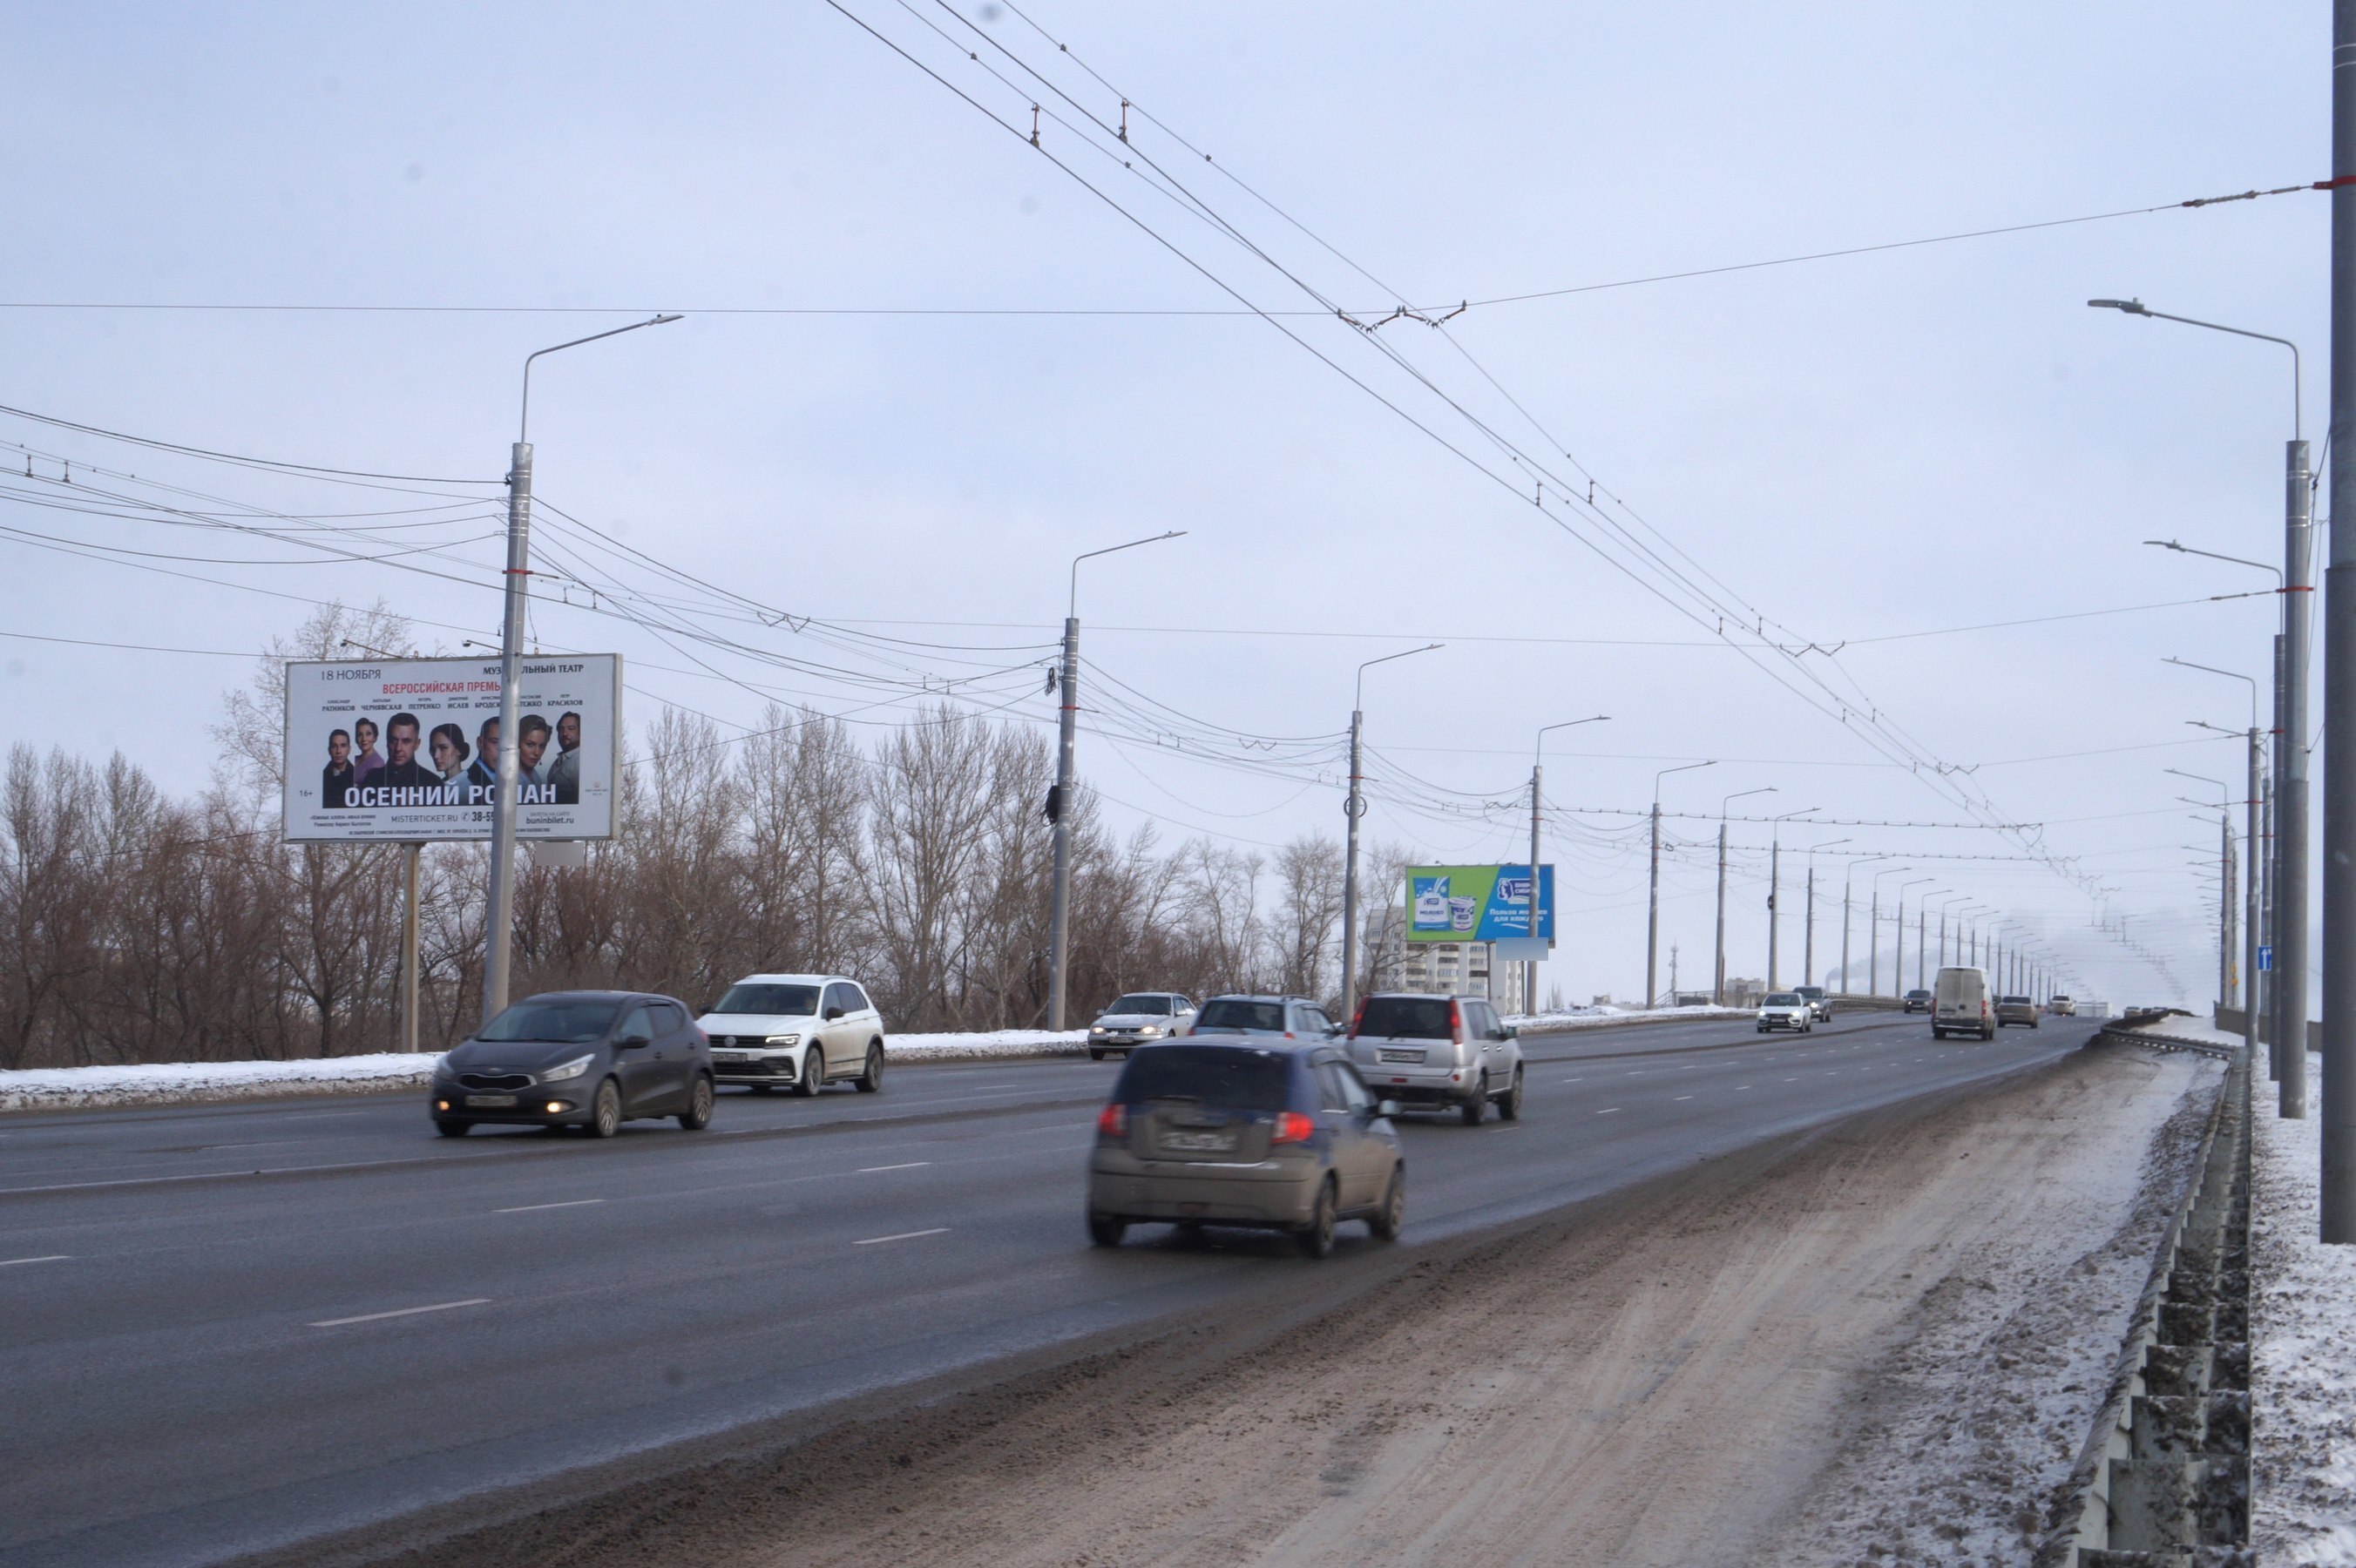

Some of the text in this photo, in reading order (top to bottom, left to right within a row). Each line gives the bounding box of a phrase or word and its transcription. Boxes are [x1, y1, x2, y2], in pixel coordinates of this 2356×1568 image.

[559, 664, 585, 673] ТЕАТР
[322, 669, 381, 680] 18 НОЯБРЯ
[383, 681, 464, 694] ВСЕРОССИЙСКАЯ
[344, 781, 556, 808] ОСЕННИЙ РОАН
[391, 814, 458, 823] MISTERTICKET.RU
